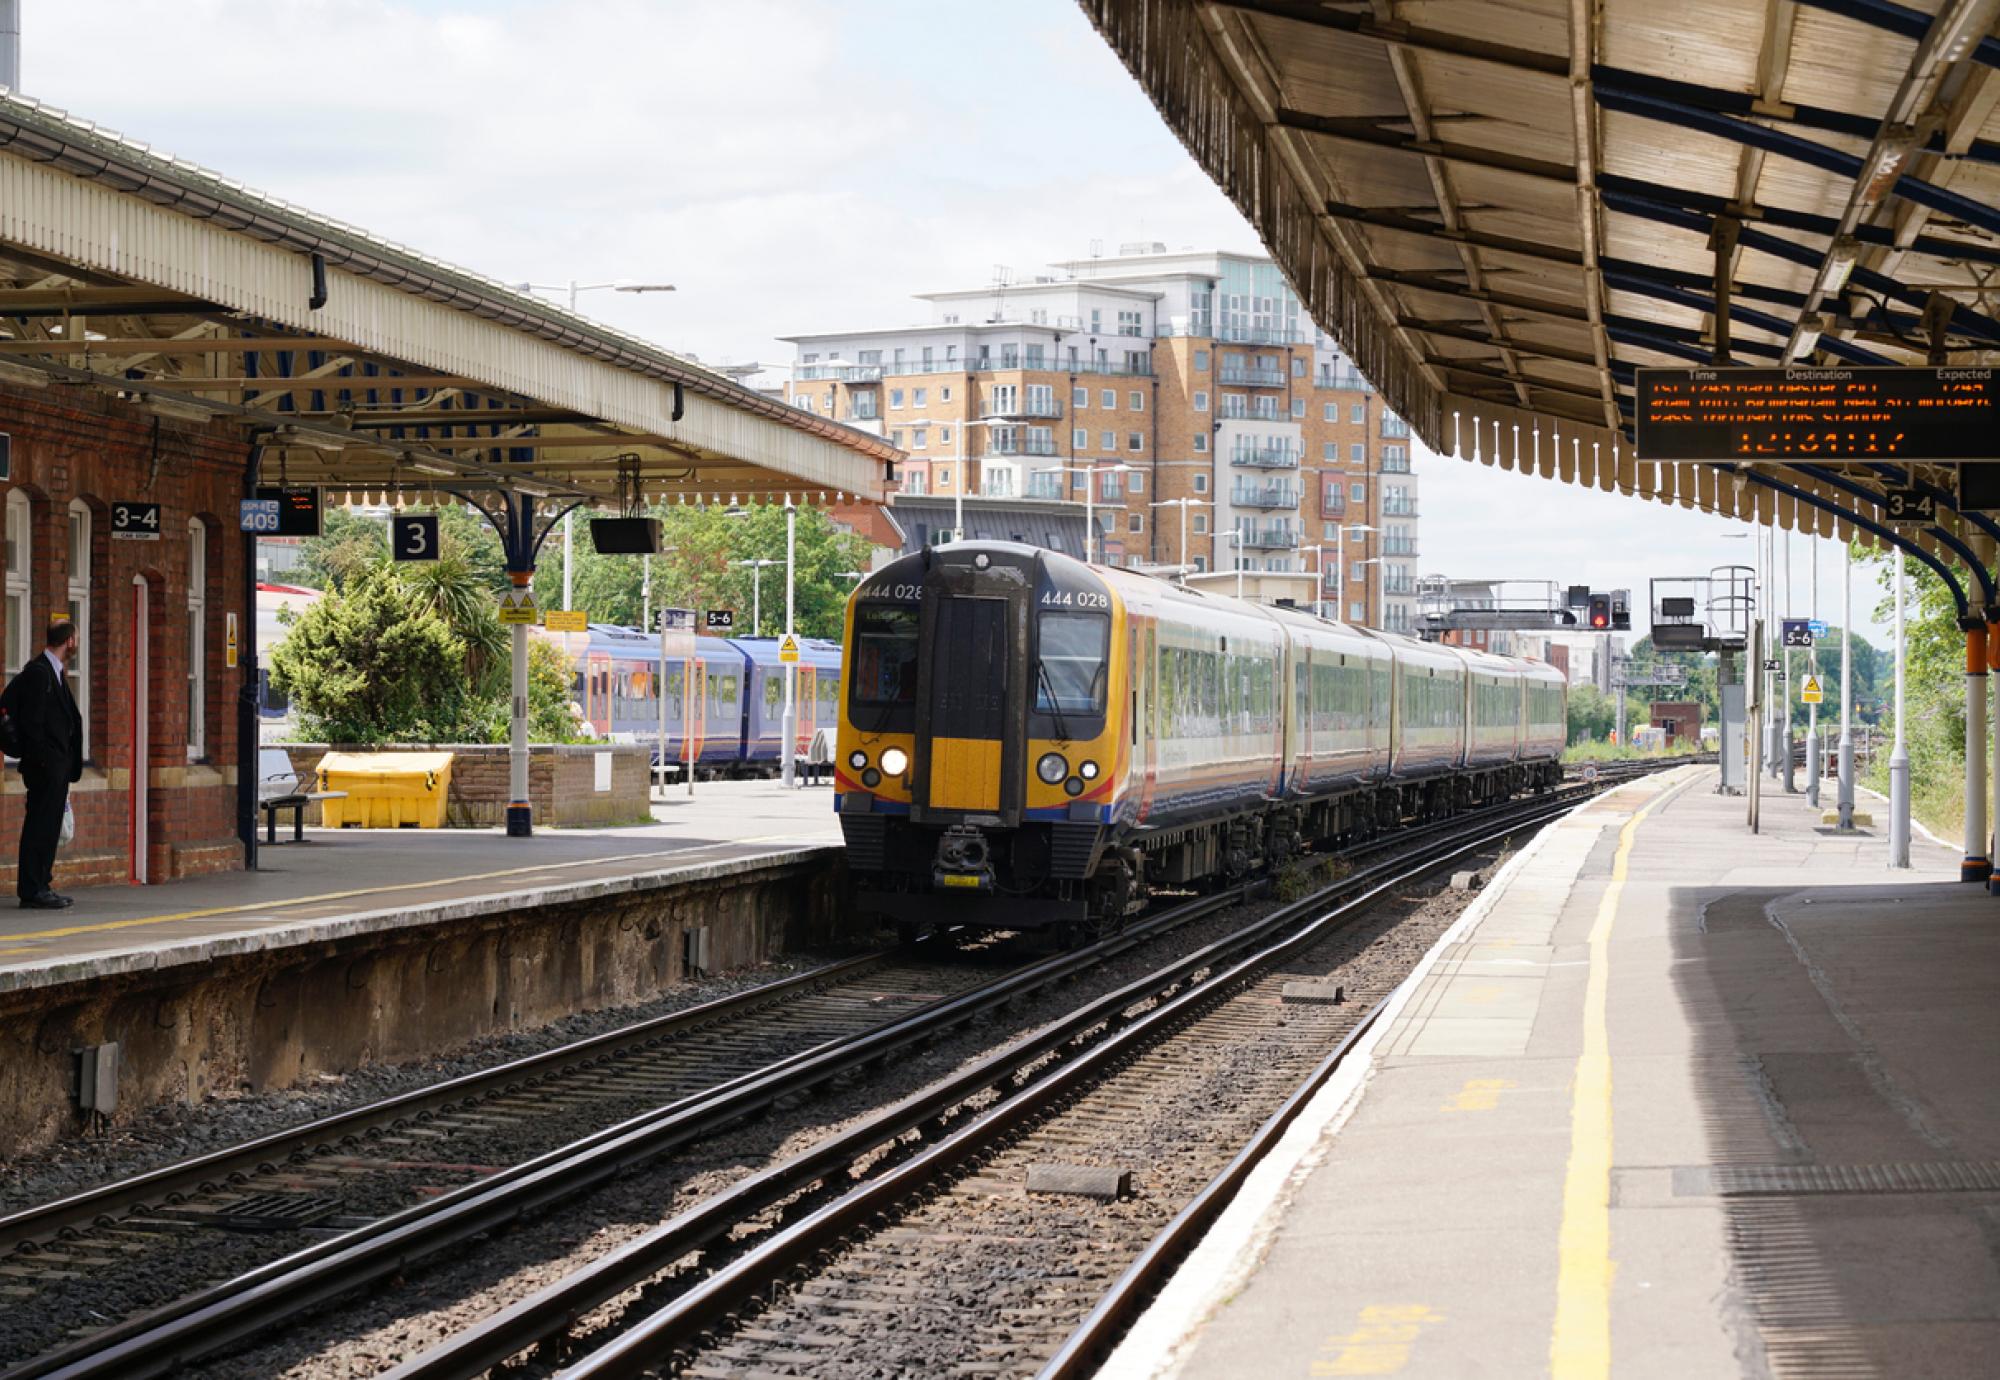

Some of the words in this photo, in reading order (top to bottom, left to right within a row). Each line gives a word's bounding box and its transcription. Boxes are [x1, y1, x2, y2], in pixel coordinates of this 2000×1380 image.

[1688, 369, 1718, 381] Time
[1785, 369, 1852, 381] Destination
[1936, 368, 1992, 381] Expected
[1890, 495, 1933, 516] 3-4
[115, 506, 158, 529] 3-4
[241, 513, 279, 529] 409
[406, 522, 426, 554] 3
[1041, 591, 1072, 606] 444
[1078, 592, 1108, 607] 028
[709, 613, 731, 625] 5-6
[1788, 631, 1810, 645] 5-6
